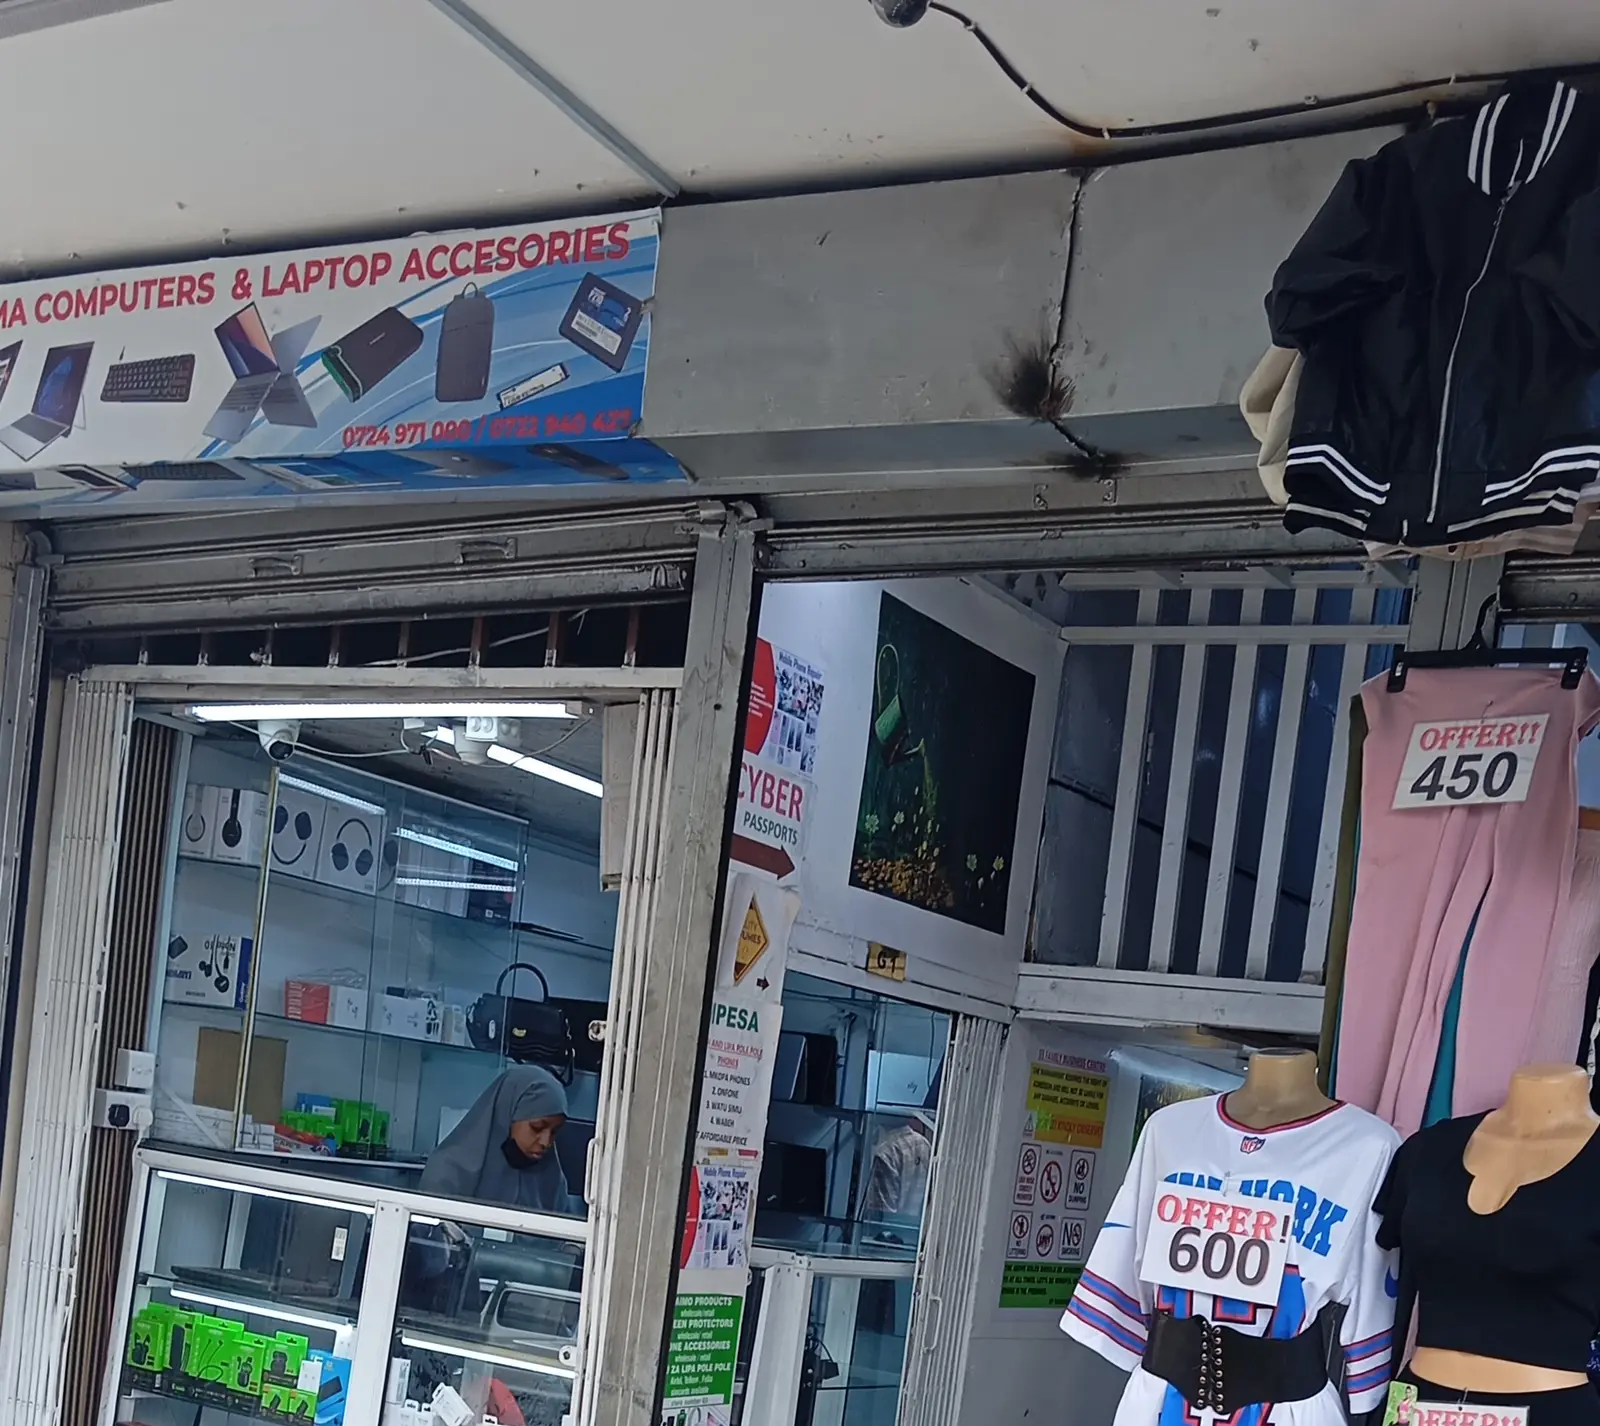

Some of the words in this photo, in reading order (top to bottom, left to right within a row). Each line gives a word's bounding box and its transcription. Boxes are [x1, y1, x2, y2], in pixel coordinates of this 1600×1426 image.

[34, 272, 215, 323] COMPUTERS
[231, 268, 252, 300] &
[261, 252, 392, 297] LAPTOP
[400, 222, 630, 282] ACCESORIES
[342, 424, 390, 448] 0724
[395, 421, 427, 444] 971
[1419, 721, 1541, 751] OFFER!!
[1410, 751, 1518, 801] 450
[743, 810, 799, 845] PASSPORTS
[729, 1074, 751, 1086] PHONES
[699, 1131, 732, 1144] AFFORDABLE
[732, 1136, 748, 1146] PRICE
[1073, 1181, 1085, 1195] NO
[1168, 1226, 1270, 1287] 600
[694, 1296, 733, 1307] PRODUCTS
[688, 1318, 734, 1328] PROTECTORS
[683, 1340, 731, 1351] ACCESSORIES
[671, 1365, 680, 1374] ZA
[681, 1364, 696, 1374] LIPA
[697, 1363, 713, 1373] POLE
[714, 1362, 732, 1372] POLE
